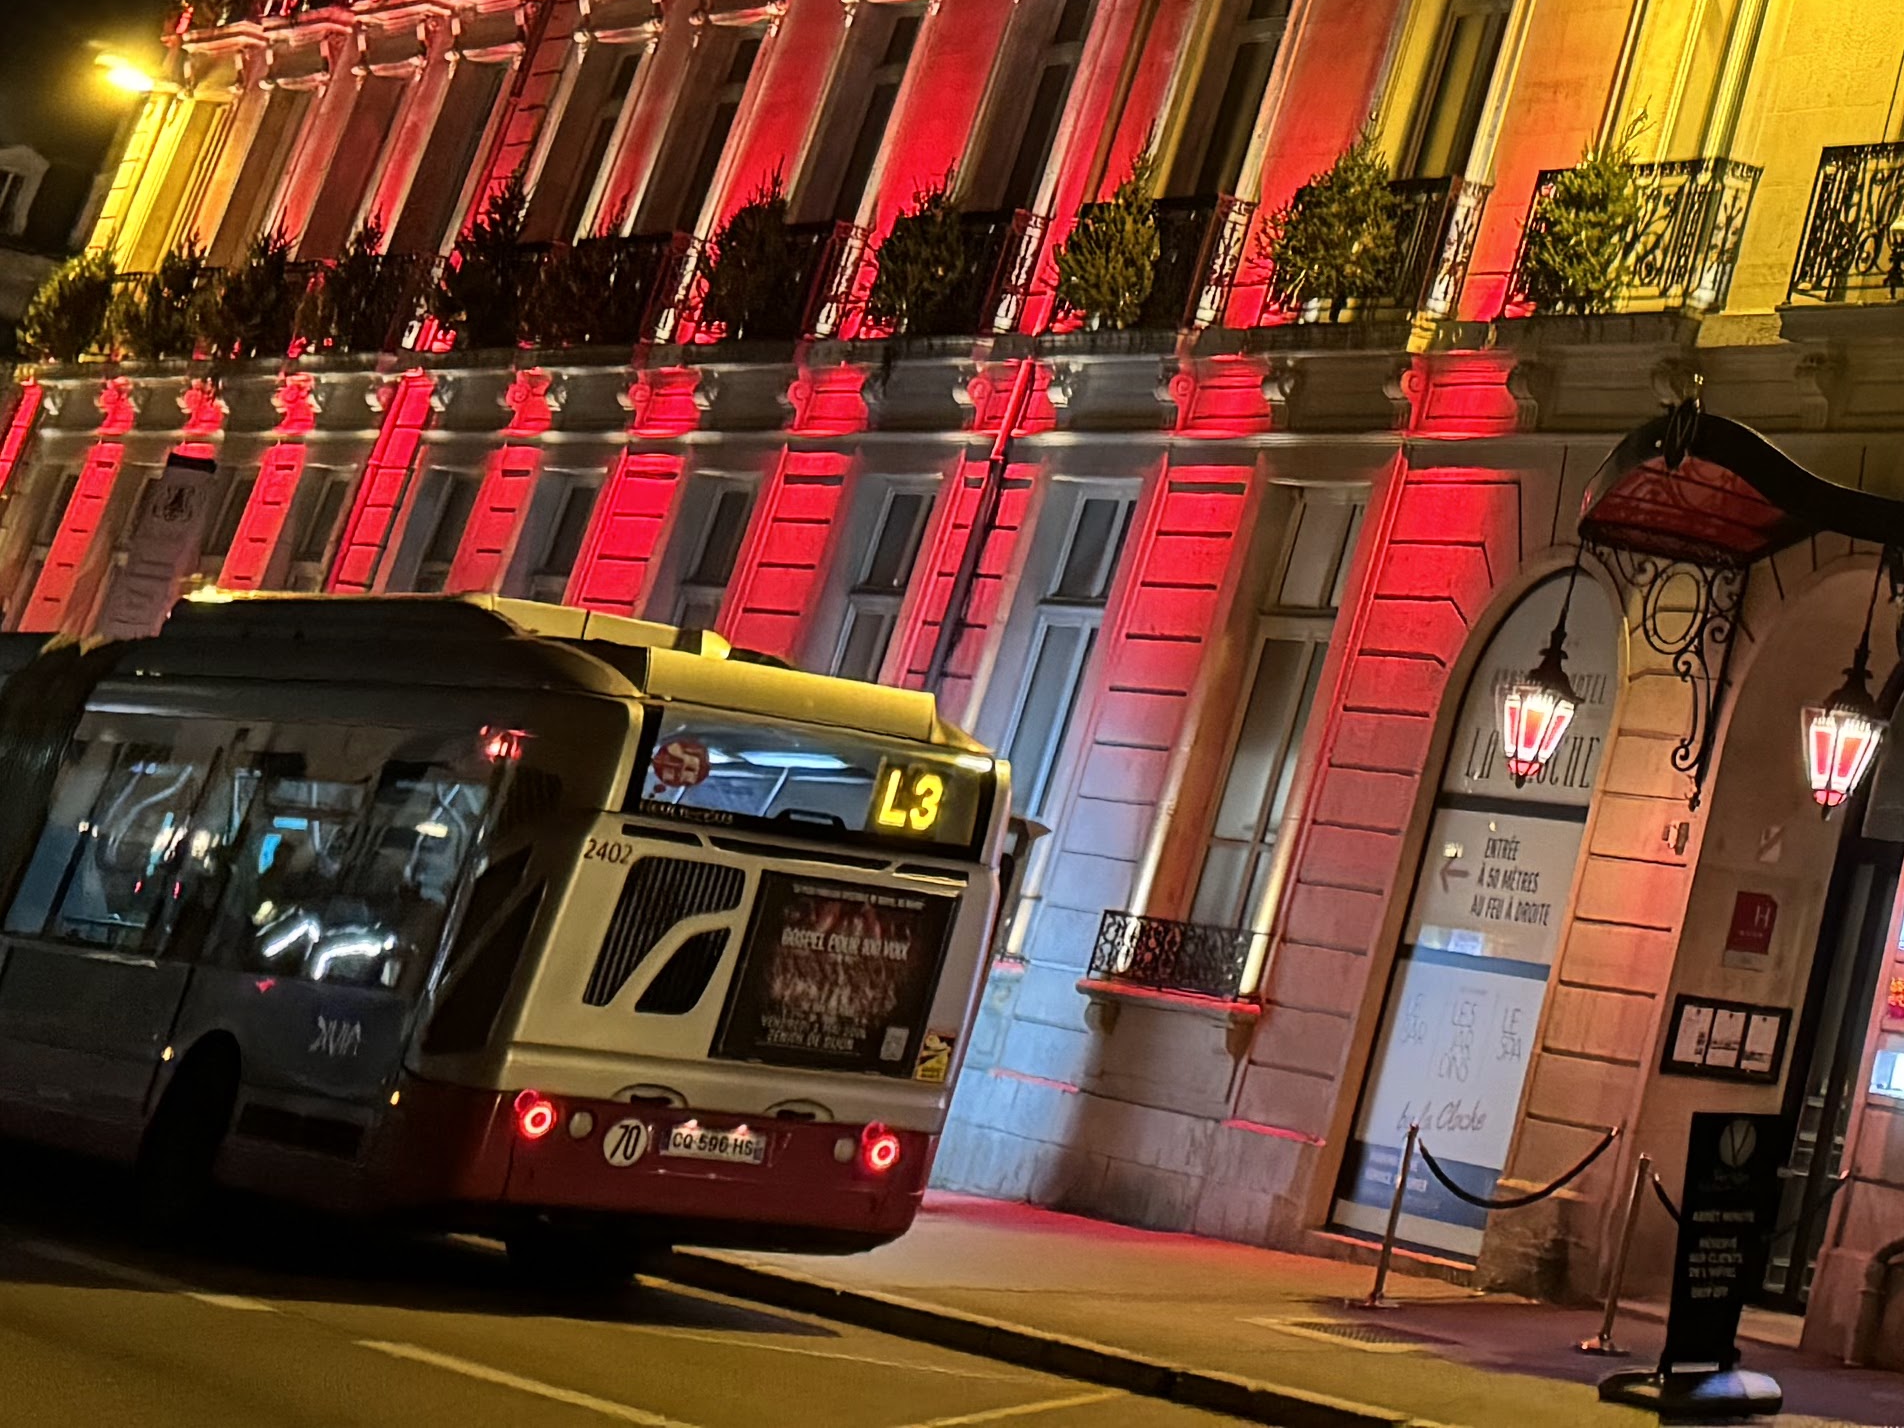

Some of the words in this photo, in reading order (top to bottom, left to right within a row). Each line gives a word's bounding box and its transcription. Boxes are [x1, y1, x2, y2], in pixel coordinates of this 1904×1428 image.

[877, 768, 945, 831] L3
[583, 838, 633, 865] 2402
[1484, 835, 1520, 861] ENTRÉE
[1477, 862, 1486, 887] À
[1487, 867, 1500, 889] 50
[1501, 866, 1539, 893] MÈTRES
[1470, 895, 1484, 917] AU
[1484, 898, 1503, 920] FEU
[1514, 902, 1551, 926] DROITE
[610, 1124, 642, 1161] 70
